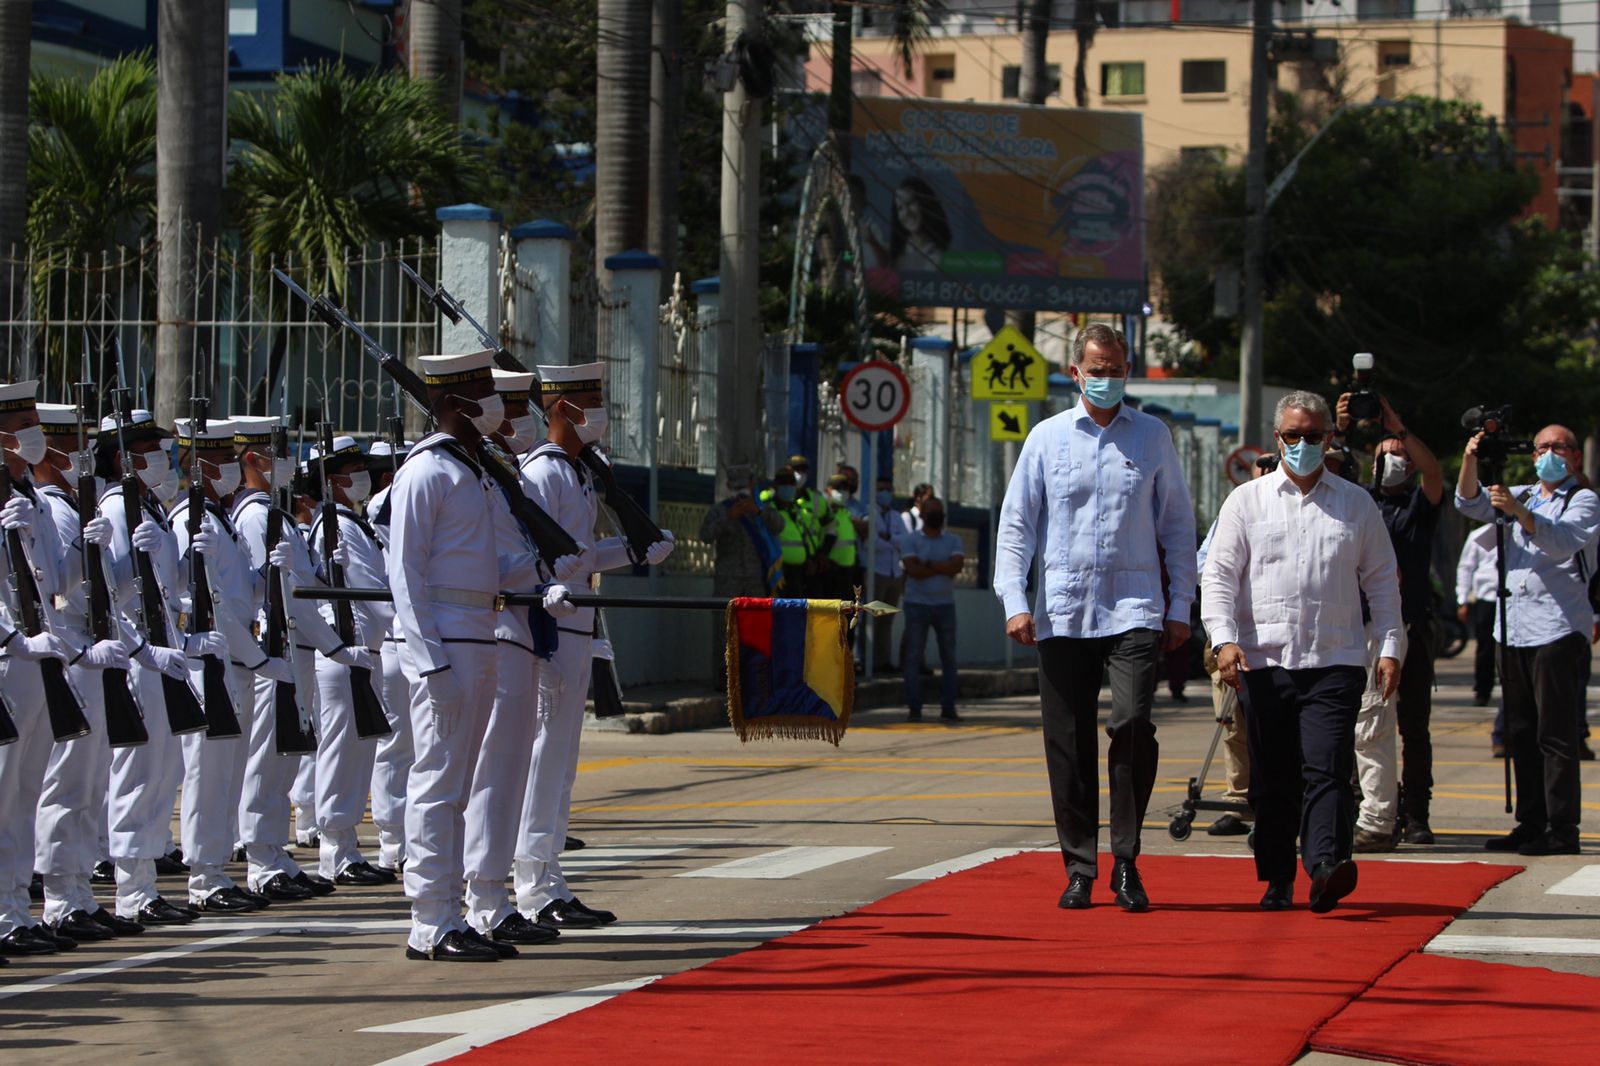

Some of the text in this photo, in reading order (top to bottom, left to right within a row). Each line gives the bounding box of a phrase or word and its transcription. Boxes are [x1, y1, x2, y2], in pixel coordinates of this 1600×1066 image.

[901, 109, 1020, 136] COLEGIO DE
[902, 279, 936, 301] 314
[979, 283, 1030, 304] 0662
[852, 378, 896, 412] 30
